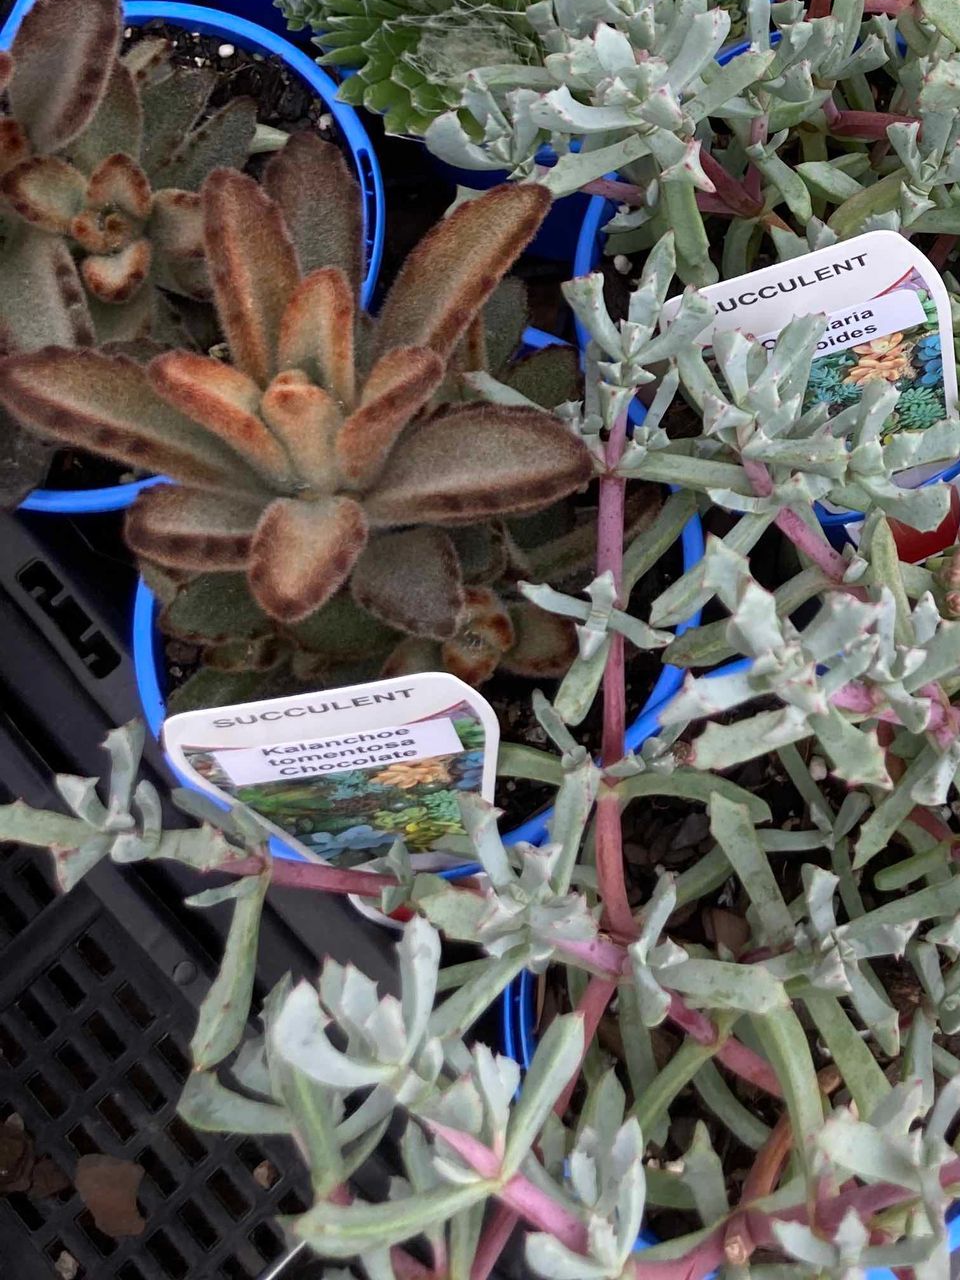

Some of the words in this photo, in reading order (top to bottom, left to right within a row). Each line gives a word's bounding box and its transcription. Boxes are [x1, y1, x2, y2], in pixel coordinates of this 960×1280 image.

[715, 253, 868, 315] UCCULENT
[213, 688, 414, 728] SUCCULENT
[262, 727, 410, 756] Kalanchoe
[268, 738, 416, 766] tomentosa
[279, 750, 418, 776] Chocolate
